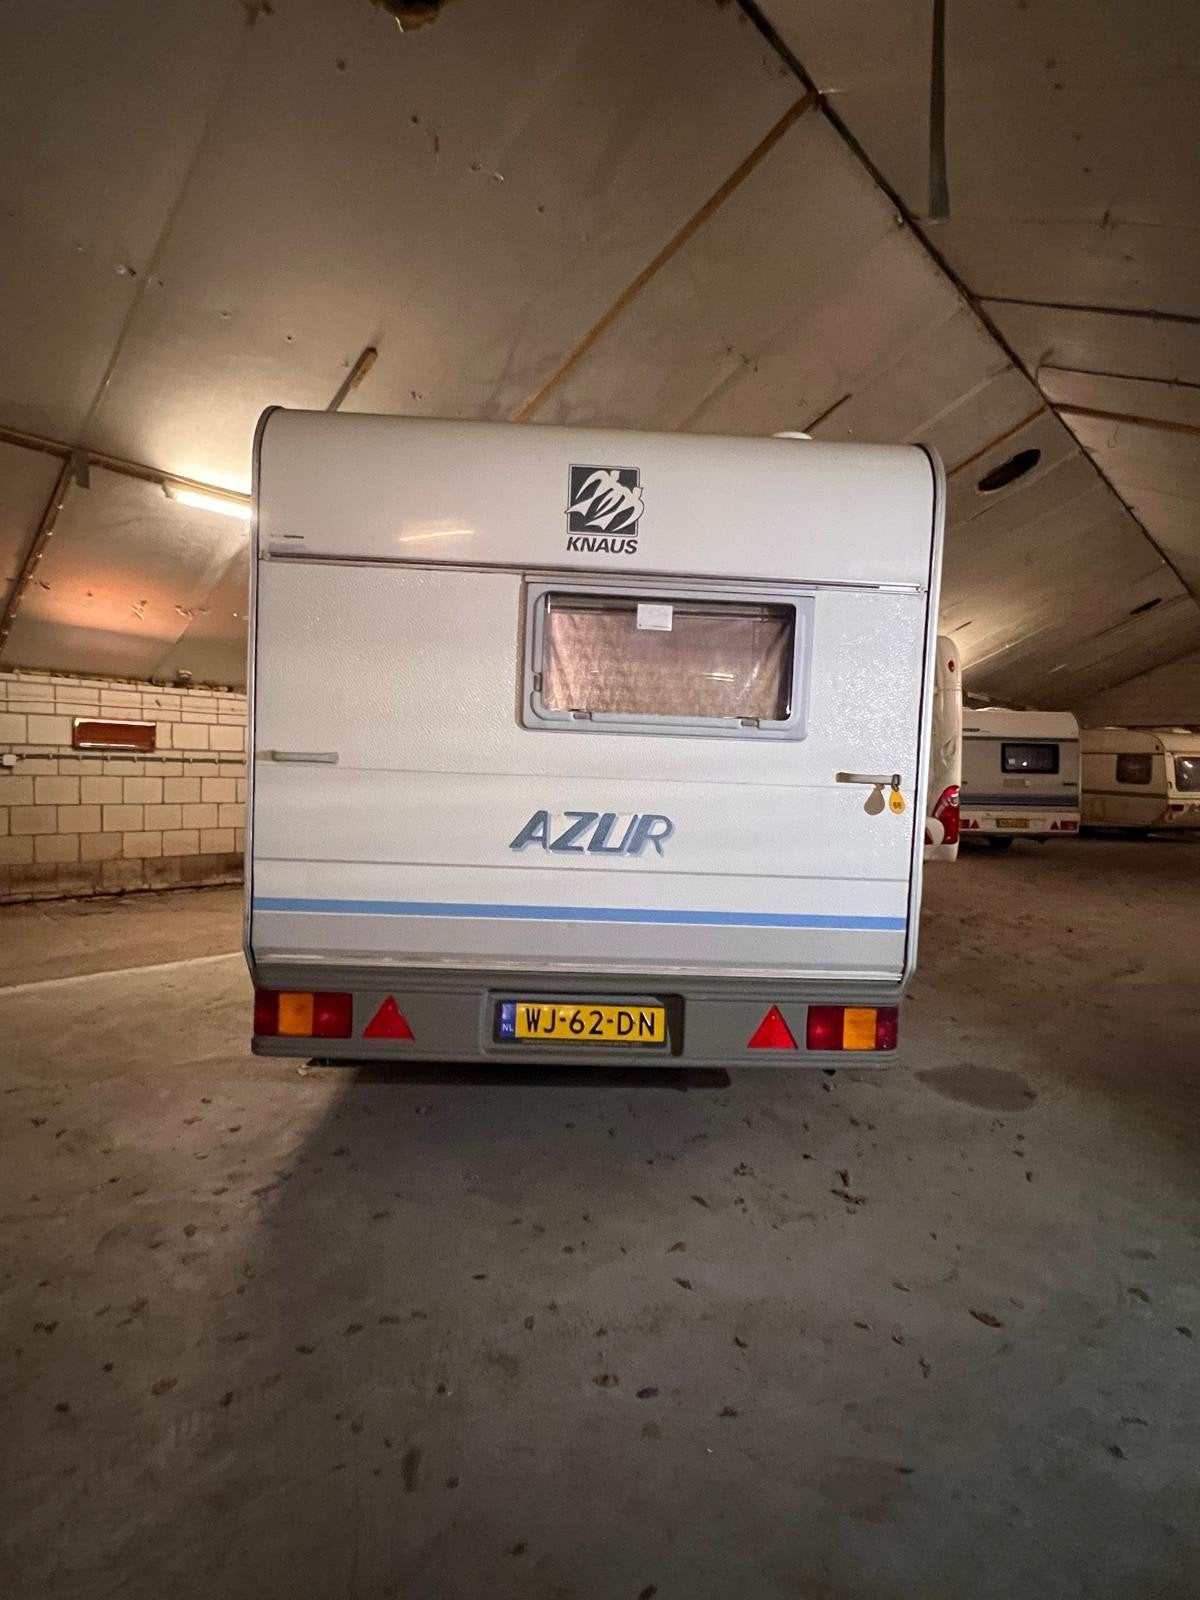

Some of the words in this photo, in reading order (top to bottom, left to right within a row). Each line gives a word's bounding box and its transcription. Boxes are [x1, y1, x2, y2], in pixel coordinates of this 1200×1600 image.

[567, 537, 638, 554] KNAUS
[509, 810, 674, 857] AZUR
[502, 1024, 514, 1032] NL
[526, 1008, 655, 1036] WJ-62-DN
